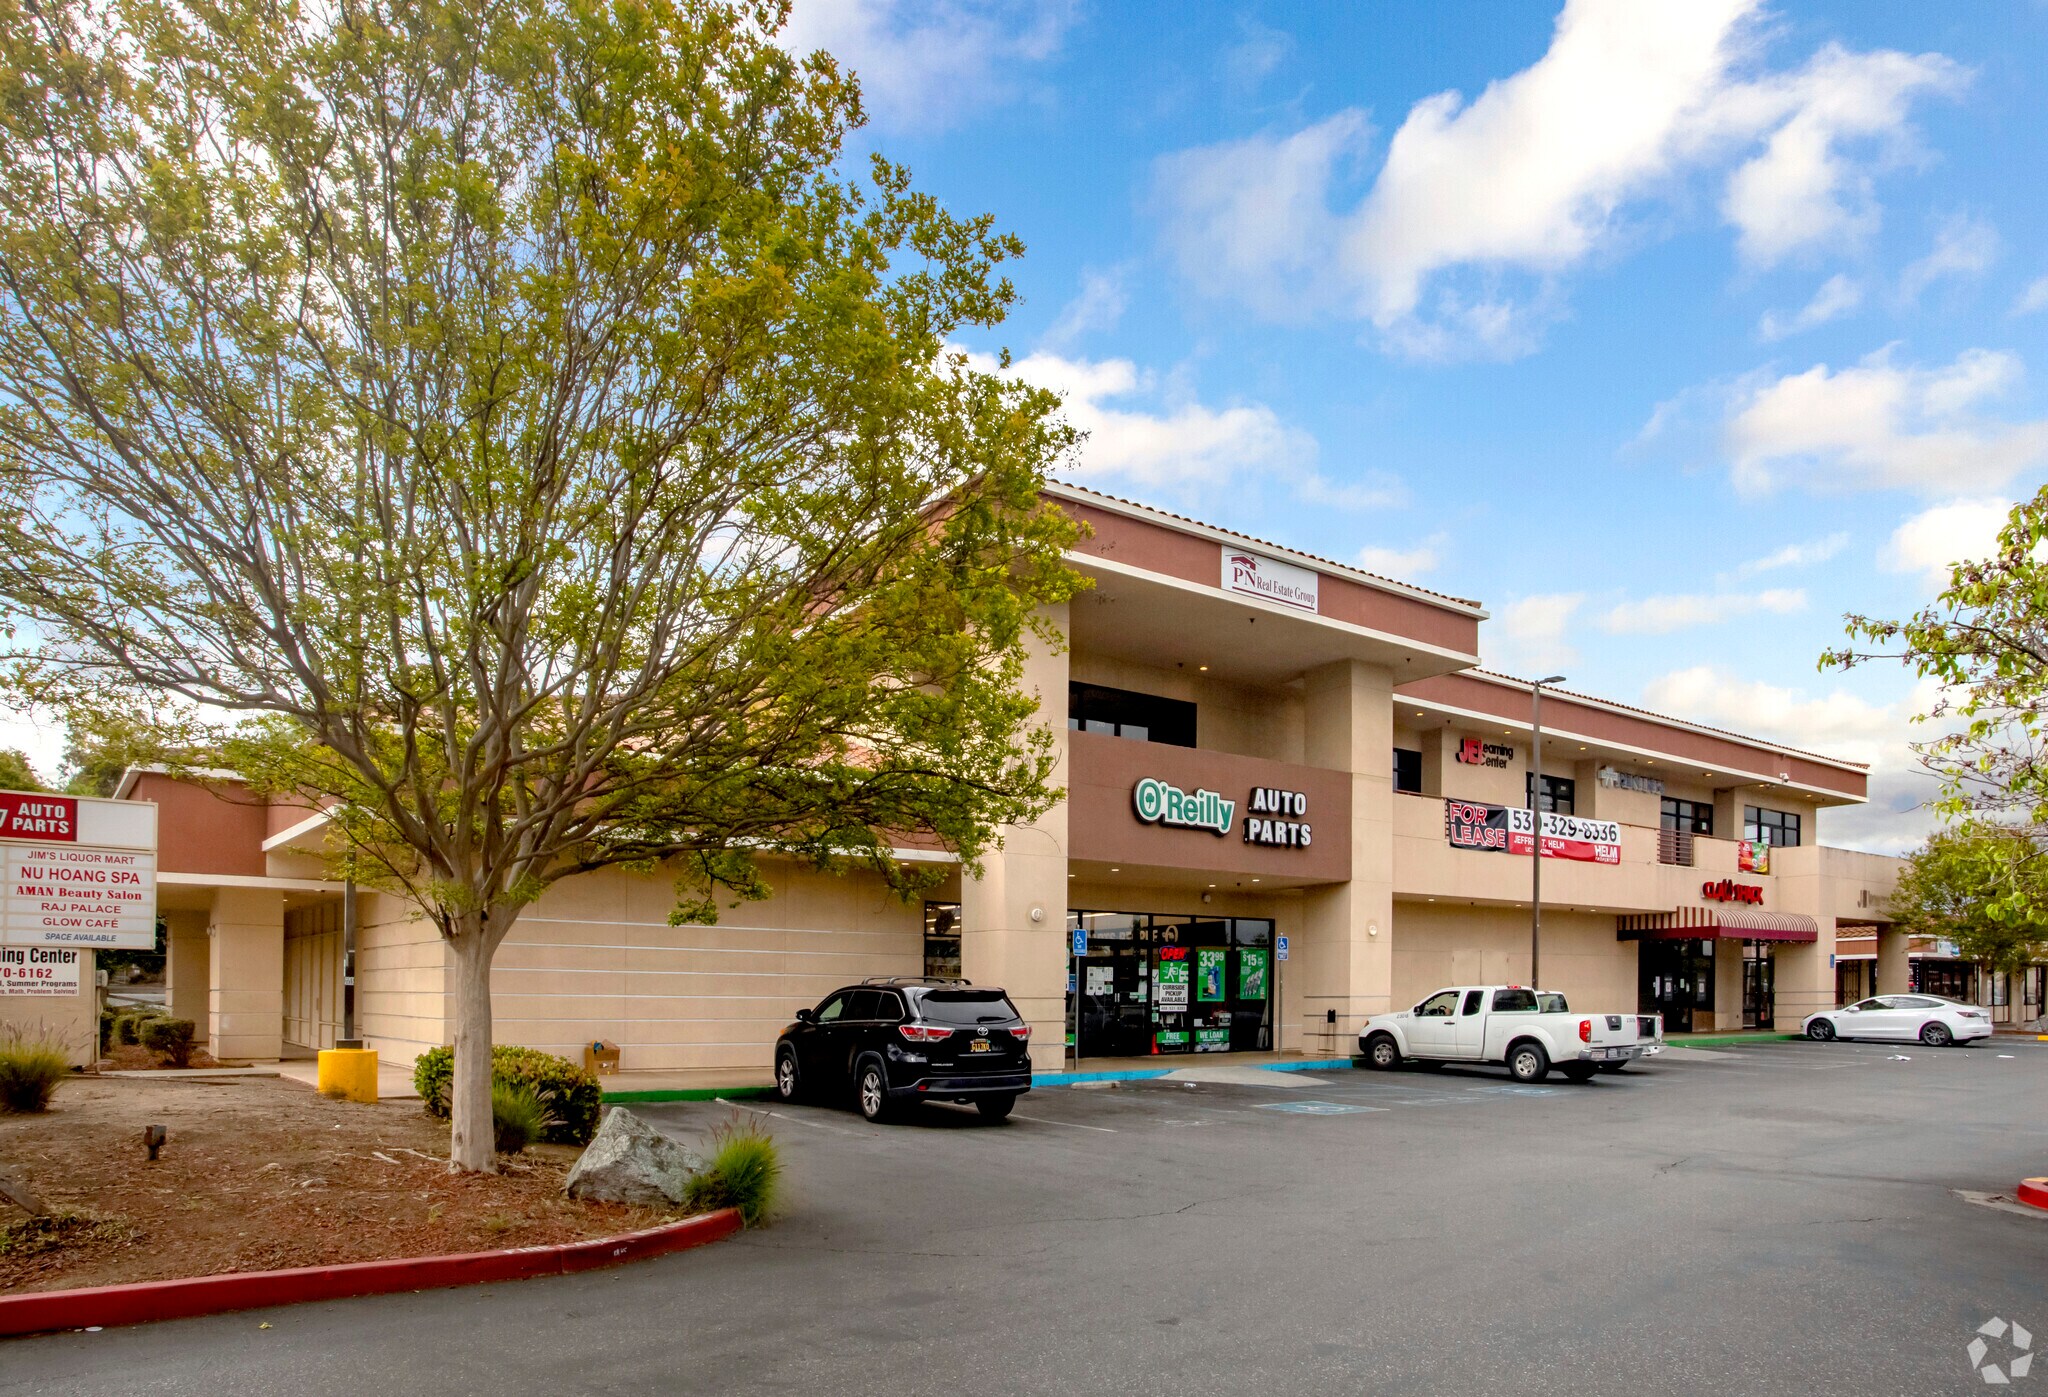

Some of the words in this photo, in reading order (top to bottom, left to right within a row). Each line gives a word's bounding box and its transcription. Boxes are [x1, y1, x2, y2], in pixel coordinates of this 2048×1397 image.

[1233, 567, 1256, 587] PN
[1257, 576, 1272, 591] Real
[1274, 580, 1294, 598] Estate
[1294, 586, 1315, 607] Group
[1483, 743, 1513, 760] earning
[1137, 780, 1234, 832] O'Reilly
[1253, 788, 1307, 815] AUTO
[18, 802, 66, 819] AUTO
[1450, 803, 1487, 826] FOR
[12, 817, 69, 834] PARTS
[1249, 818, 1312, 846] PARTS
[1451, 824, 1506, 848] LEASE
[1548, 839, 1565, 850] HELM
[28, 851, 56, 860] JIM'S
[60, 852, 102, 863] LIQUOR
[105, 855, 135, 865] MART
[1594, 844, 1618, 859] HELM
[21, 866, 44, 880] NU
[49, 867, 106, 883] HOANG
[111, 871, 140, 884] SPA
[16, 885, 54, 897] AMAN
[59, 887, 104, 900] Beauty
[107, 889, 142, 901] Salon
[41, 902, 67, 912] RAJ
[71, 903, 122, 914] PALACE
[42, 917, 82, 927] GLOW
[85, 918, 119, 928] CAFÉ
[45, 932, 72, 941] SPACE
[73, 933, 117, 942] AVAILABLE
[0, 947, 25, 965] ing
[30, 947, 78, 964] Center
[1161, 947, 1186, 960] OPEN
[41, 980, 78, 988] Programs
[1166, 1032, 1180, 1040] FREE
